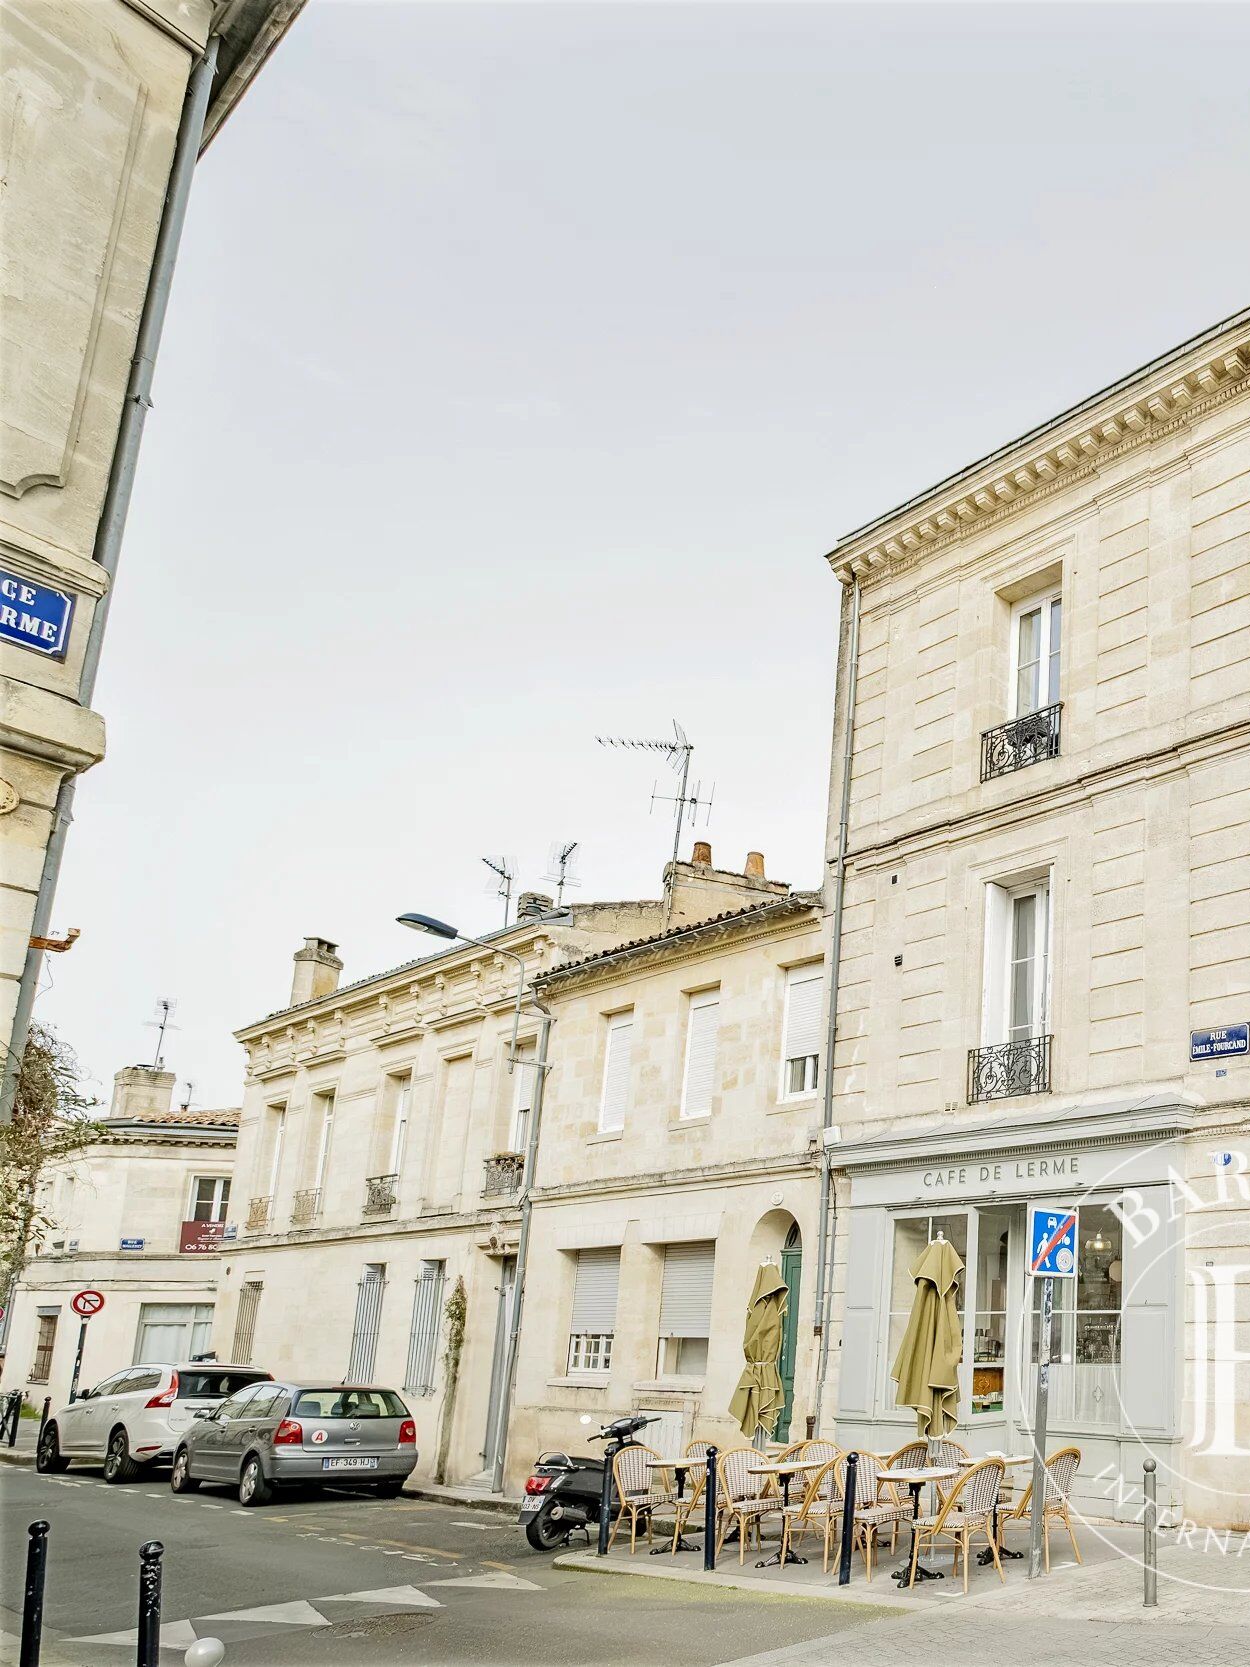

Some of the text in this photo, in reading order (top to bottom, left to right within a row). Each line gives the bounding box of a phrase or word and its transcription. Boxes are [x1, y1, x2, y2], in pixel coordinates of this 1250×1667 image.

[0, 605, 57, 642] RME
[1210, 1030, 1227, 1041] RUE
[923, 1157, 1079, 1187] CAFÉ DE LERME
[315, 1432, 323, 1442] A
